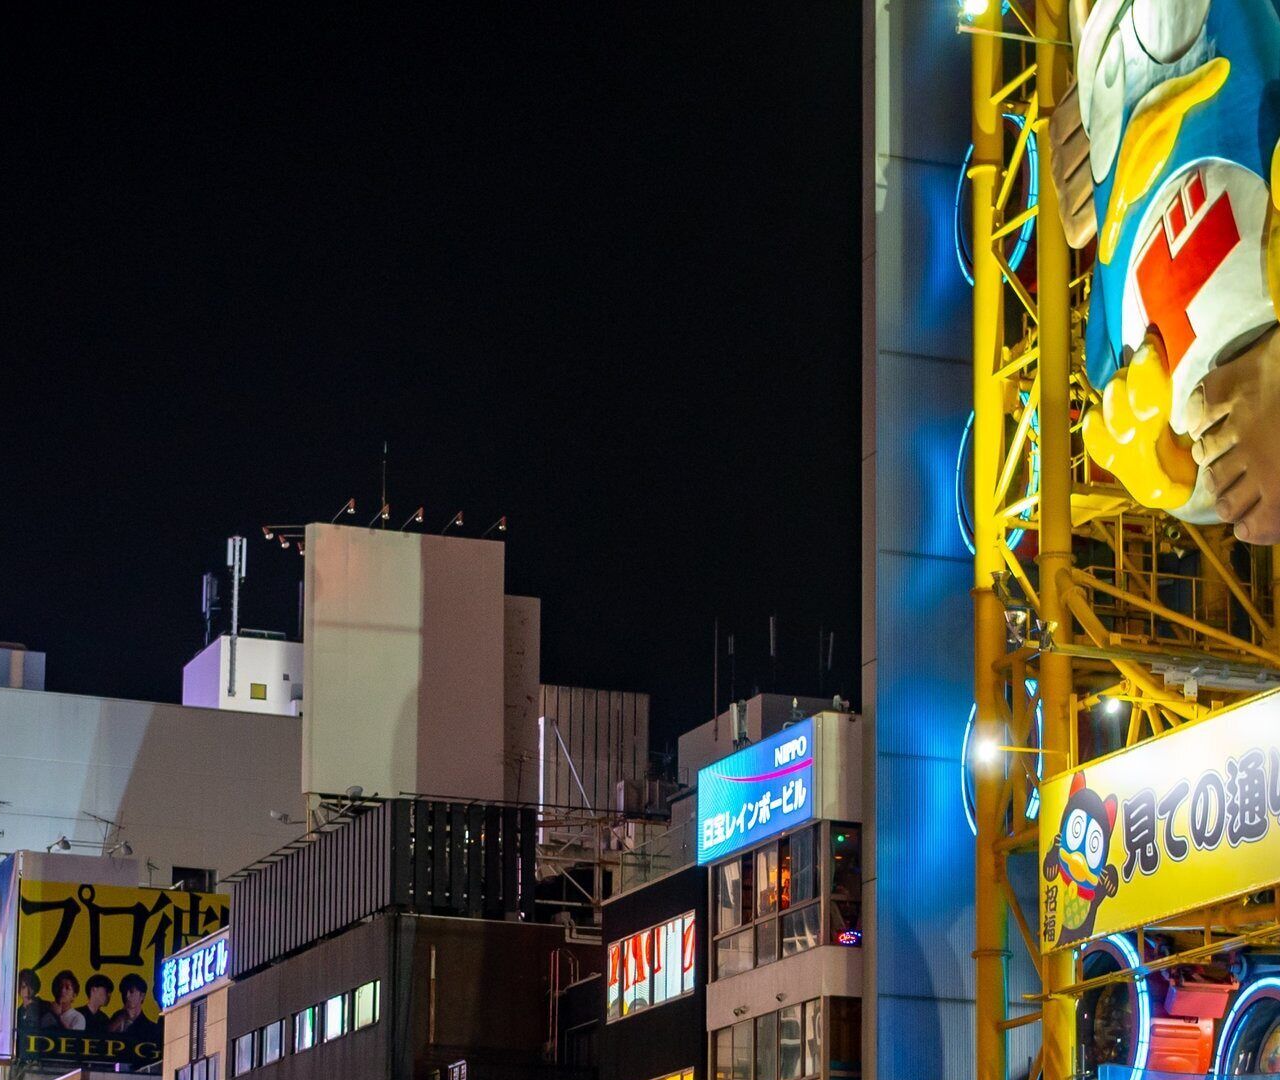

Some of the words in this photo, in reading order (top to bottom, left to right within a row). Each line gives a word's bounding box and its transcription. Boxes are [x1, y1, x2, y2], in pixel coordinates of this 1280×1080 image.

[774, 736, 807, 768] NIPPO
[703, 779, 807, 849] 日宝レインボービル
[27, 1036, 125, 1058] DEEP
